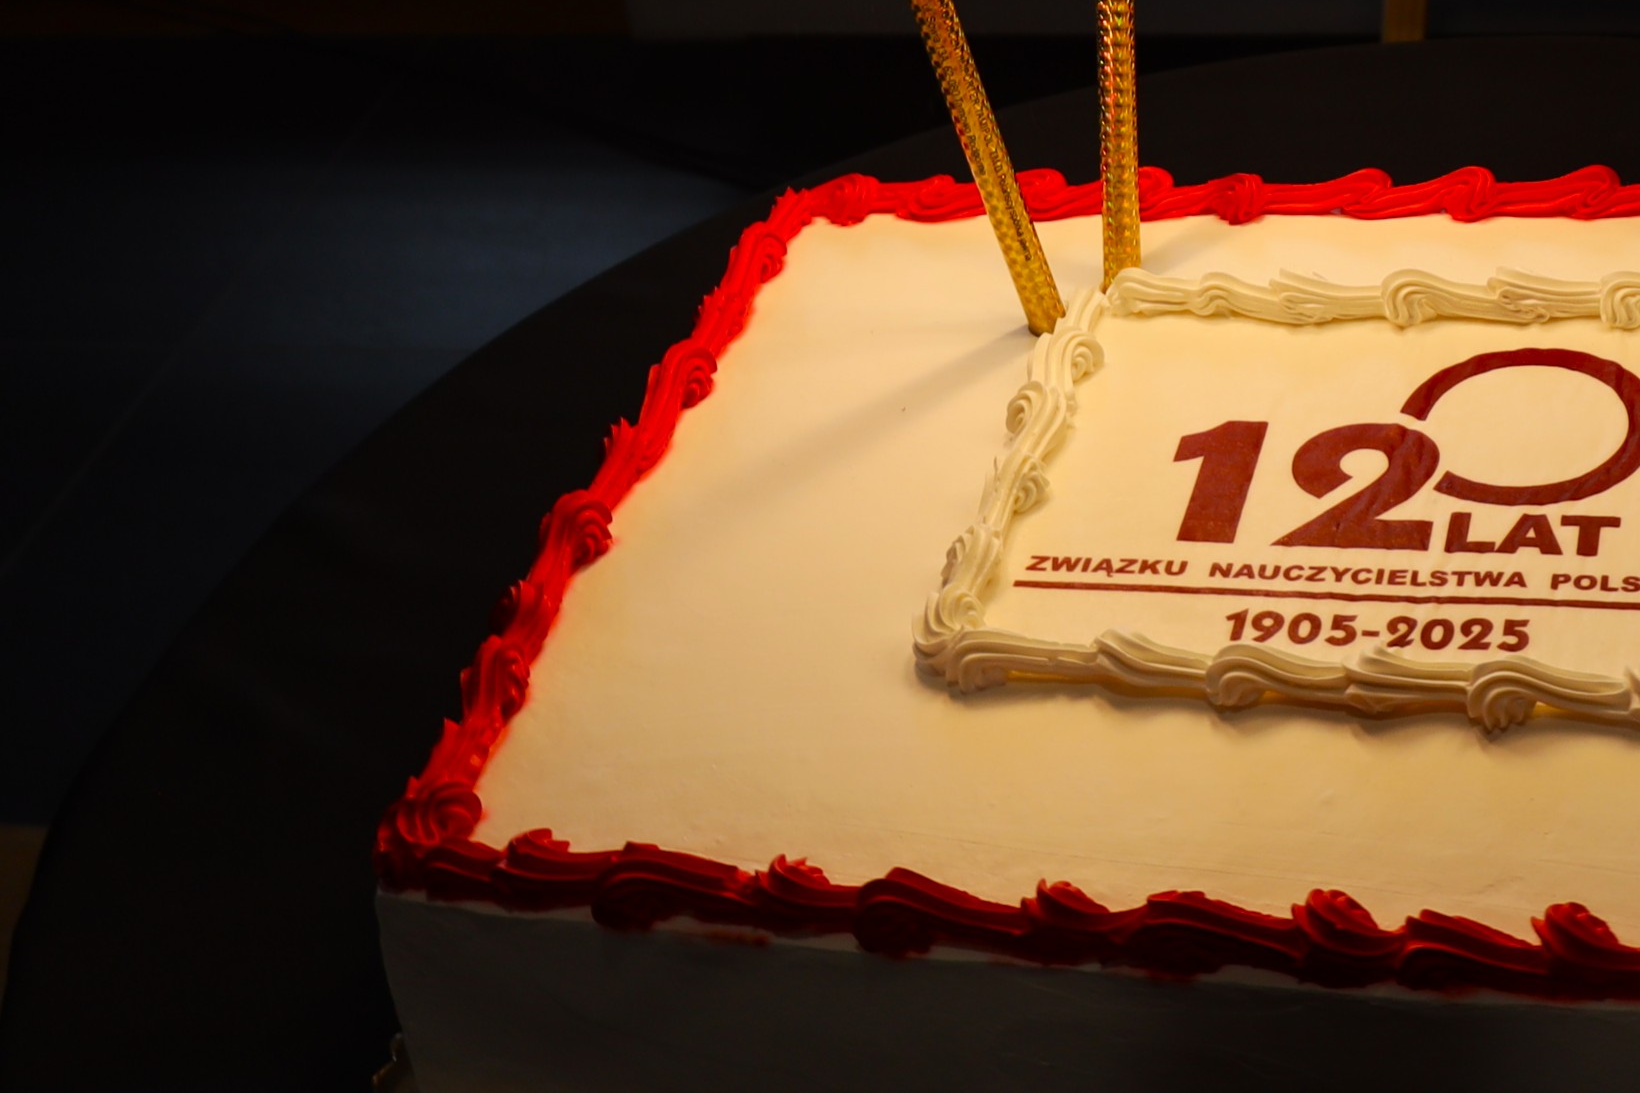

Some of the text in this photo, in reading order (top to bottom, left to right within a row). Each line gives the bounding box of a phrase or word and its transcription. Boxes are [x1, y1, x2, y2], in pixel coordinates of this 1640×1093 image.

[1445, 512, 1621, 558] LAT
[1025, 555, 1188, 578] ZWIĄZKU
[1208, 562, 1528, 588] NAUCZYCIELSTWA
[1225, 608, 1531, 653] 1905-2025
